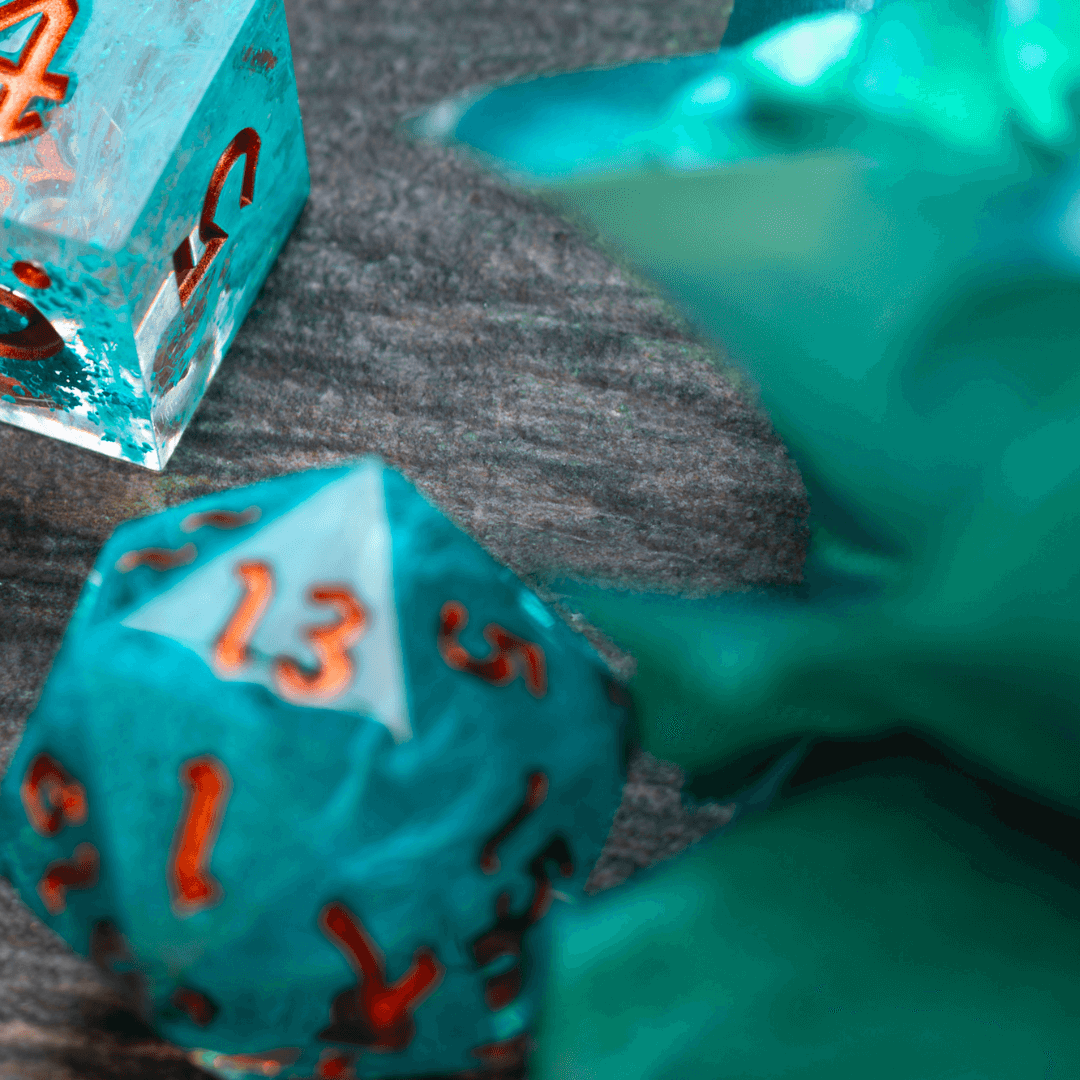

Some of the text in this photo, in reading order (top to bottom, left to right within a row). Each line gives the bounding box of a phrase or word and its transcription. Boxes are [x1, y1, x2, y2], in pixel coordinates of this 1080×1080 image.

[214, 558, 369, 706] 13
[437, 599, 550, 696] 5
[168, 754, 232, 912] 1
